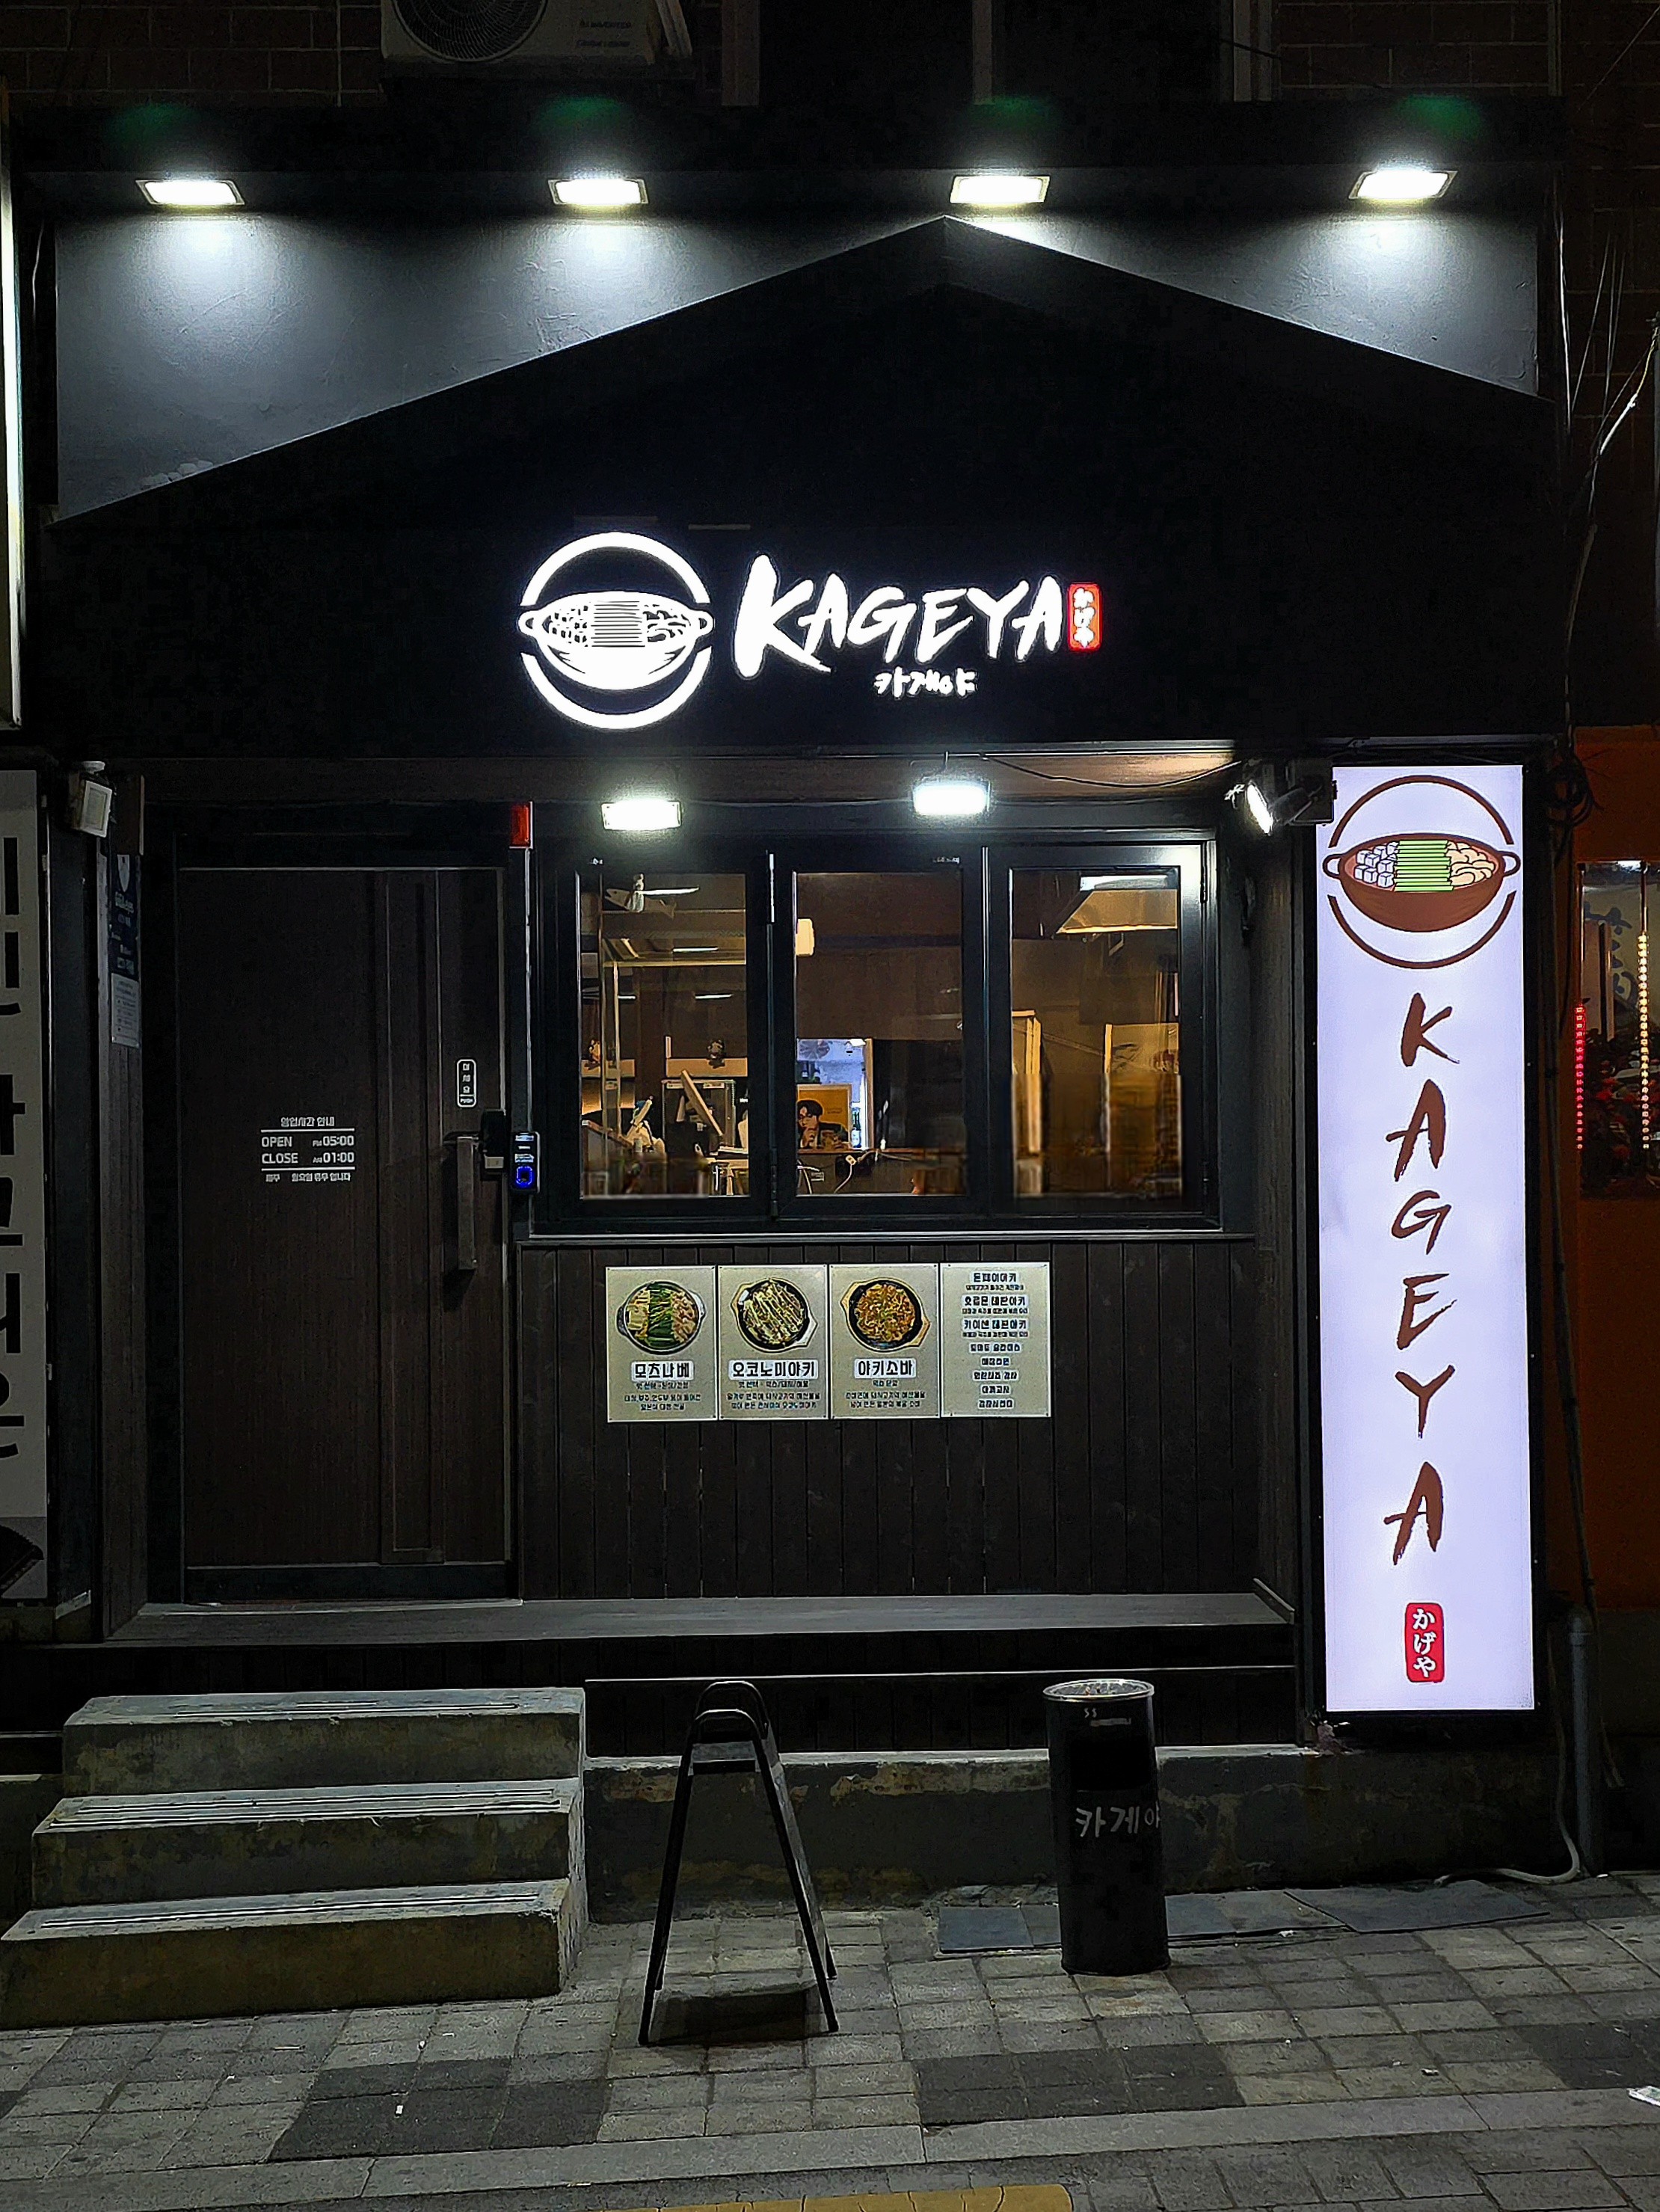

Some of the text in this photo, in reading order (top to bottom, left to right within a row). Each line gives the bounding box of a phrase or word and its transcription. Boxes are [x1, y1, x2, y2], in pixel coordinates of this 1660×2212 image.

[733, 553, 1063, 679] KAGEYA
[874, 666, 977, 698] 카게야
[280, 1116, 335, 1127] 영업시간 안내
[261, 1136, 292, 1147] OPEN
[262, 1152, 298, 1164] CLOSE
[635, 1362, 689, 1378] 모츠나베
[733, 1362, 814, 1377] 오코노미야키
[858, 1360, 913, 1376] 야키소바
[1411, 1607, 1436, 1678] かげや
